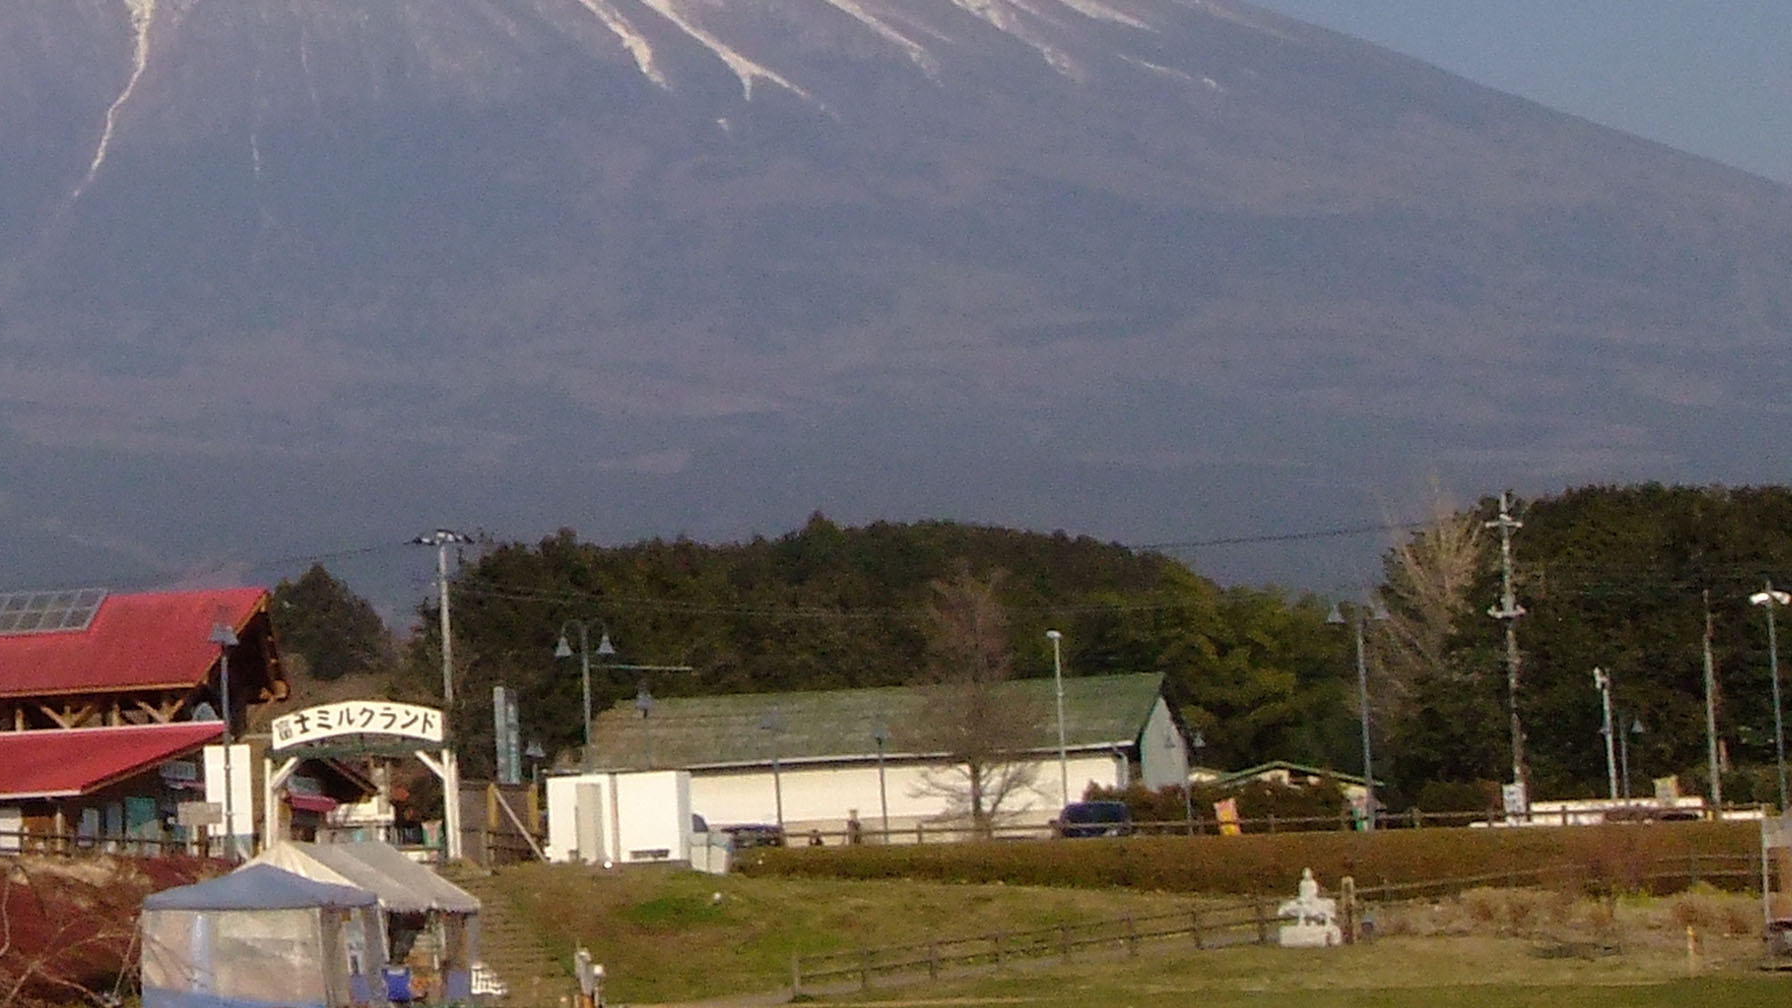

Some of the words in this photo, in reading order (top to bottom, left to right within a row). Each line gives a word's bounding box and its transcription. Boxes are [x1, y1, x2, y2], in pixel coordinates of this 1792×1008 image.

[275, 707, 435, 741] 富士ミルクランド
